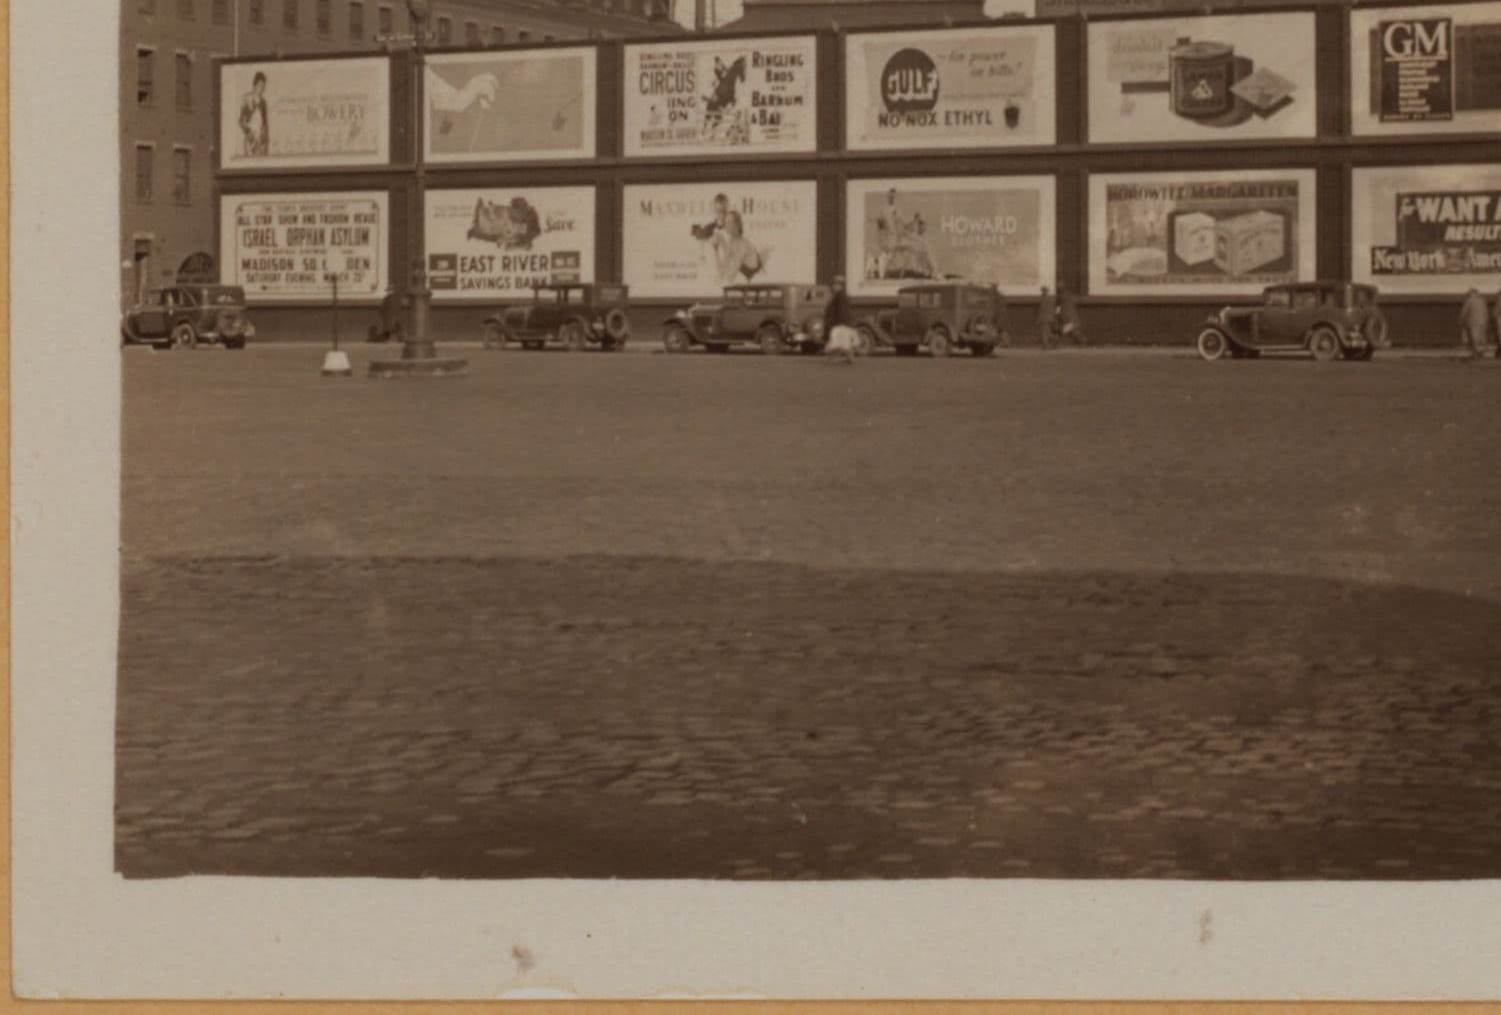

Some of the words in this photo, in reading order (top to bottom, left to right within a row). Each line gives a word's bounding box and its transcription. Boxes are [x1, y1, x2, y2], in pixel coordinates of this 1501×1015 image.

[1384, 20, 1449, 59] GM
[751, 51, 804, 68] RINGLING
[639, 70, 697, 95] CIRCUS
[887, 68, 939, 102] GULF
[751, 91, 804, 107] BARNUM
[944, 109, 993, 126] ETHYL
[1416, 195, 1492, 223] WANT
[941, 215, 1018, 235] HOWARD
[242, 228, 278, 248] ISRAEL
[286, 227, 326, 247] ORPHAN
[330, 226, 370, 247] ASYLUM
[241, 257, 294, 271] MADISON
[460, 254, 497, 273] EAST
[501, 254, 549, 272] RIVER
[1373, 249, 1407, 271] New
[1408, 250, 1446, 272] York
[460, 276, 511, 291] SAVINGS
